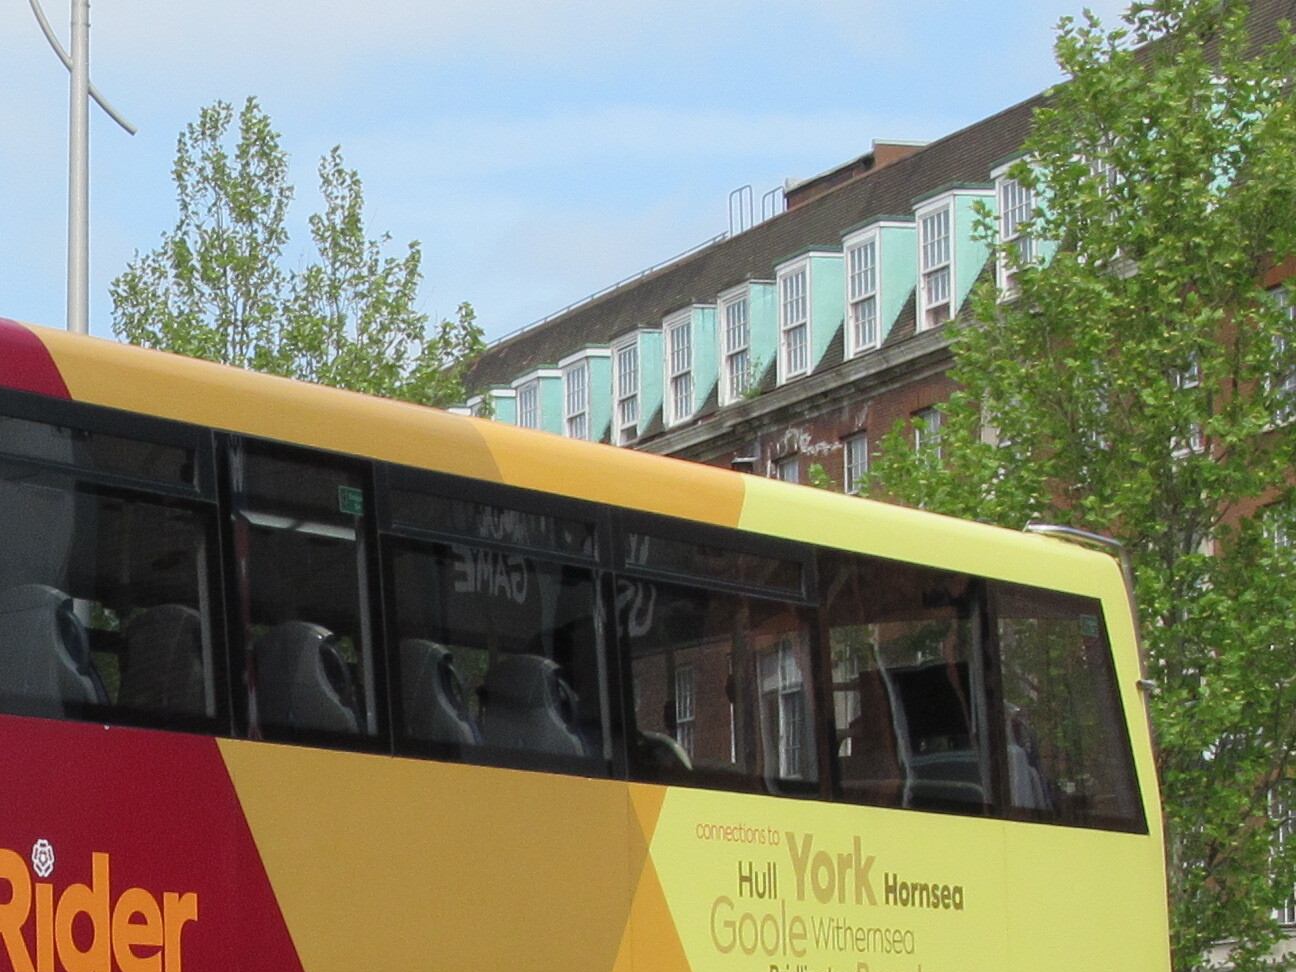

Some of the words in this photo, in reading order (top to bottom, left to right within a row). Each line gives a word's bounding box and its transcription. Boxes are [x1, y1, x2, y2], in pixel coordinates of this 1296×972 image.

[695, 822, 766, 845] connections
[767, 825, 781, 847] to
[737, 859, 778, 900] Hull
[784, 831, 878, 906] York
[883, 872, 964, 911] Hornsea
[710, 895, 808, 958] Goole
[811, 916, 915, 955] Withernsea
